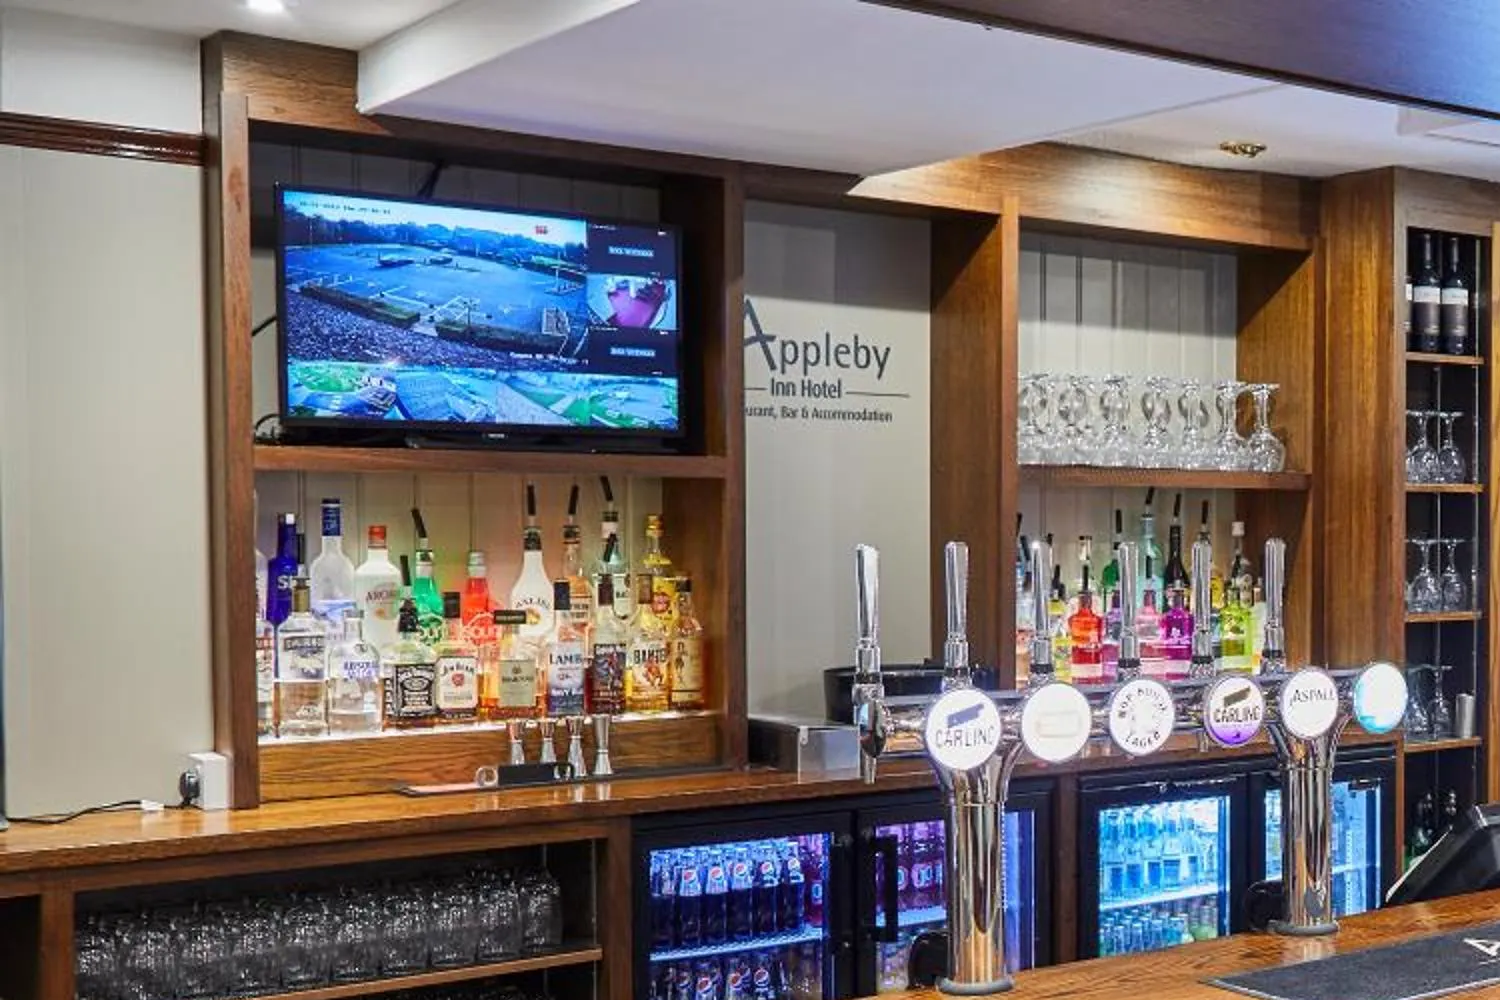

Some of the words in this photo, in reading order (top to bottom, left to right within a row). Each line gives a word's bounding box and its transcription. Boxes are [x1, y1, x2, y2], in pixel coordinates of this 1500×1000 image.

[744, 299, 891, 380] Appleby
[771, 377, 796, 396] Inn
[801, 378, 842, 398] Hotel
[781, 405, 799, 418] Bar
[811, 408, 893, 422] Accommodation
